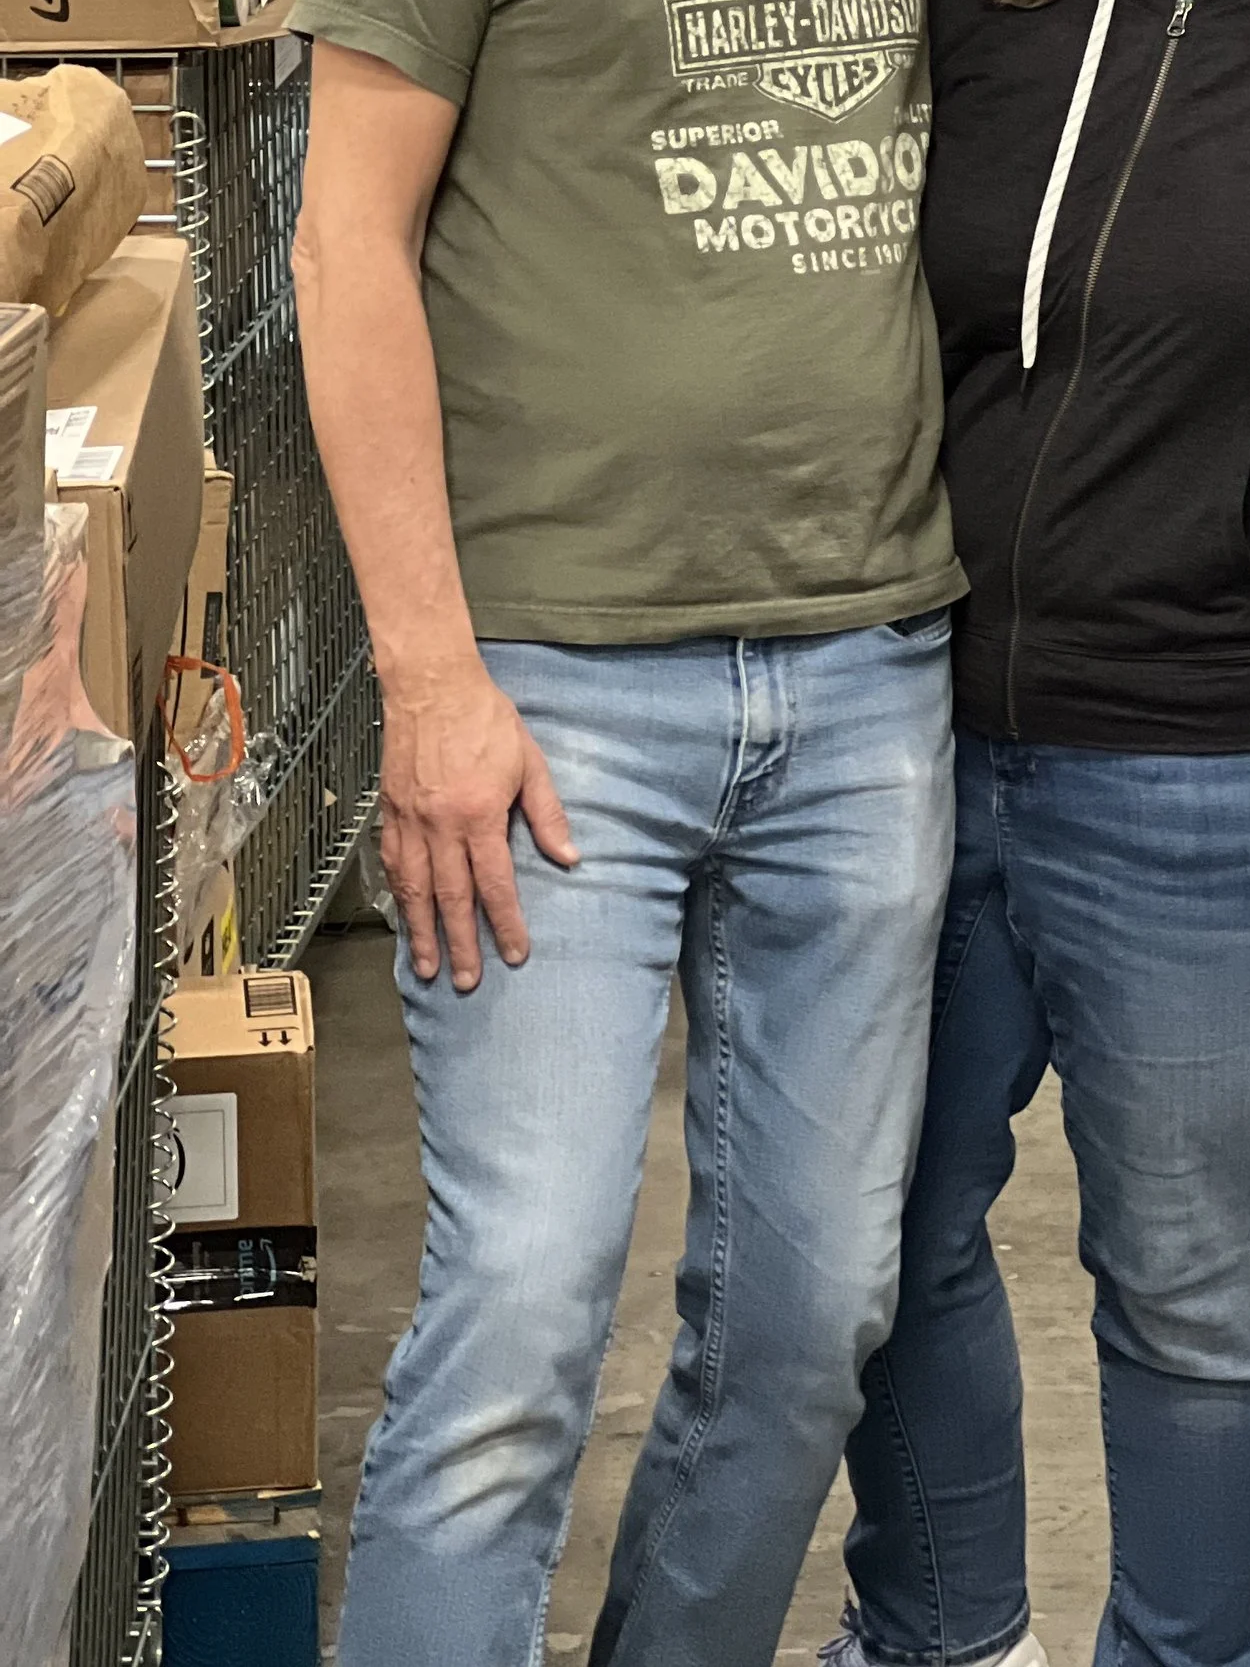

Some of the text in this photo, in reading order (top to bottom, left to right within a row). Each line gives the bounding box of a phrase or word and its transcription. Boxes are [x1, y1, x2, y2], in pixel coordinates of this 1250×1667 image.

[681, 70, 749, 93] TRADE
[771, 56, 879, 108] CYCLES
[651, 119, 785, 151] SUPERIOR
[792, 246, 867, 274] SINCE
